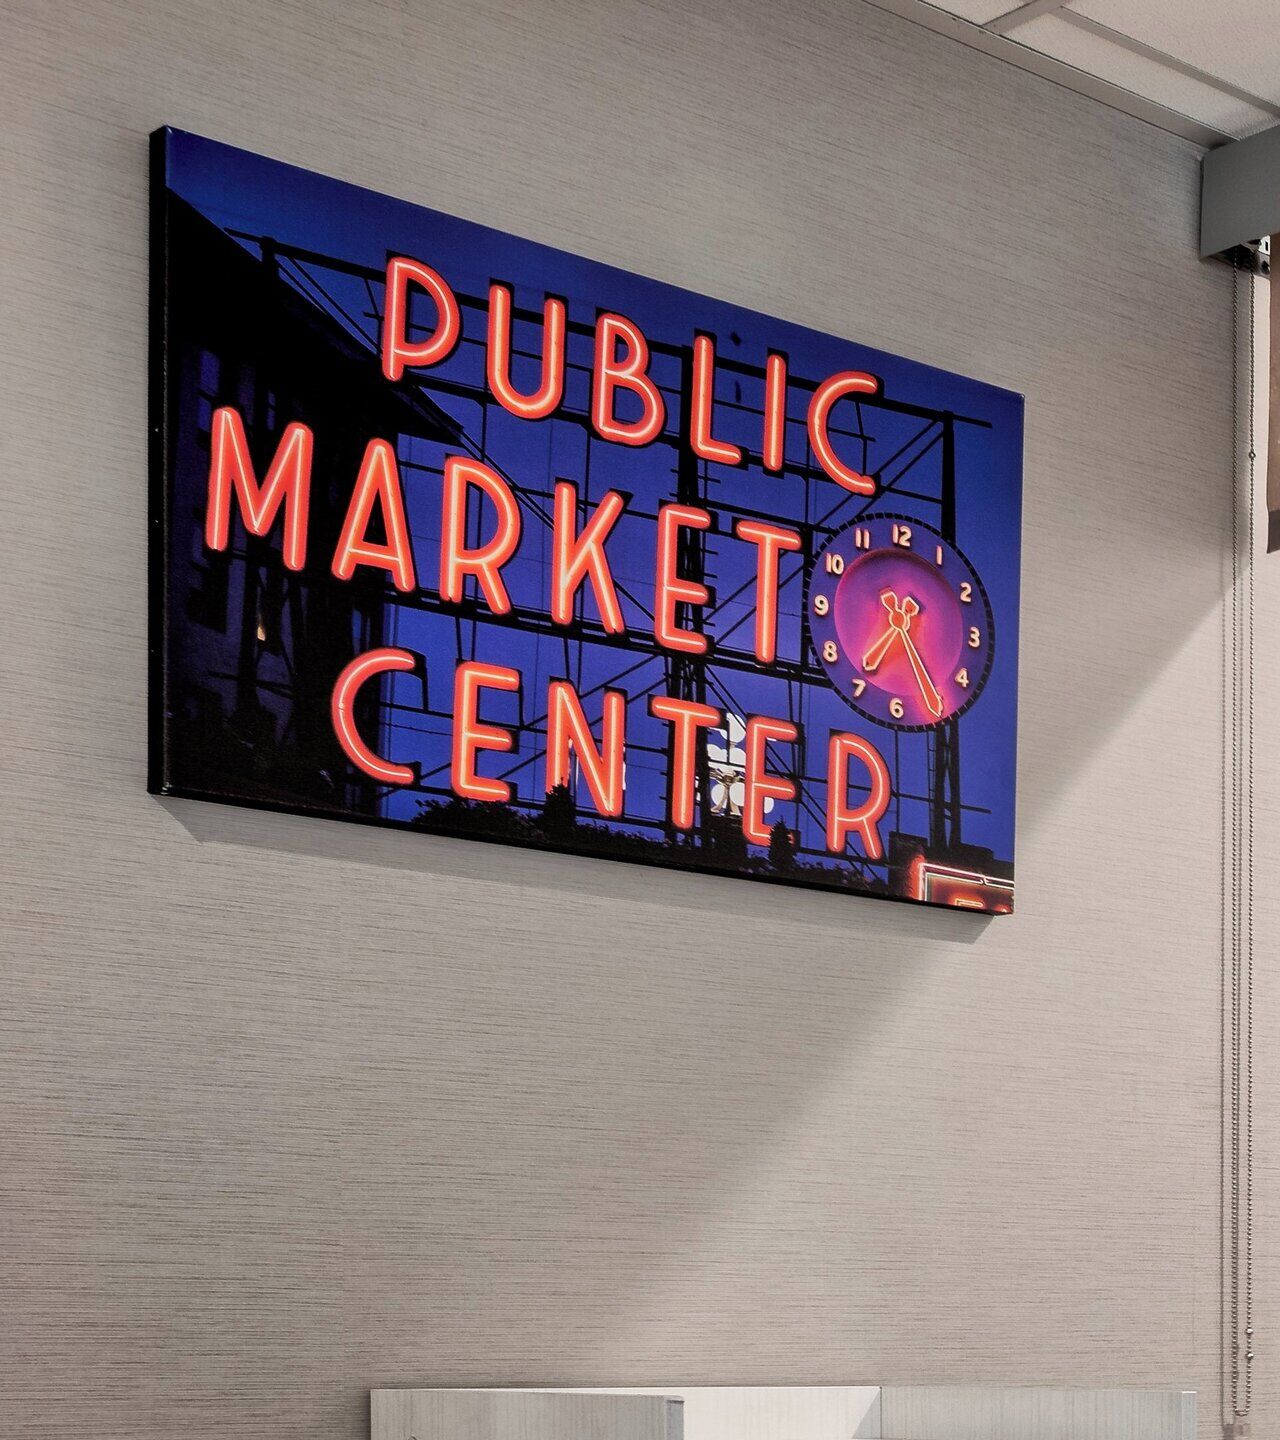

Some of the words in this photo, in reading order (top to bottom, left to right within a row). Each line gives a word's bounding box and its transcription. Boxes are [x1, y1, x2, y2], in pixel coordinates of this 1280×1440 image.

[382, 256, 880, 497] PUBLIC
[205, 406, 803, 666] MARKET
[855, 528, 870, 549] 11
[892, 524, 912, 547] 12
[826, 553, 844, 575] 10
[936, 545, 943, 565] 1
[960, 582, 972, 602] 2
[814, 594, 829, 616] 9
[968, 627, 981, 648] 3
[823, 640, 838, 663] 8
[852, 678, 866, 697] 7
[955, 668, 969, 688] 4
[889, 698, 904, 718] 6
[330, 645, 893, 861] CENTER
